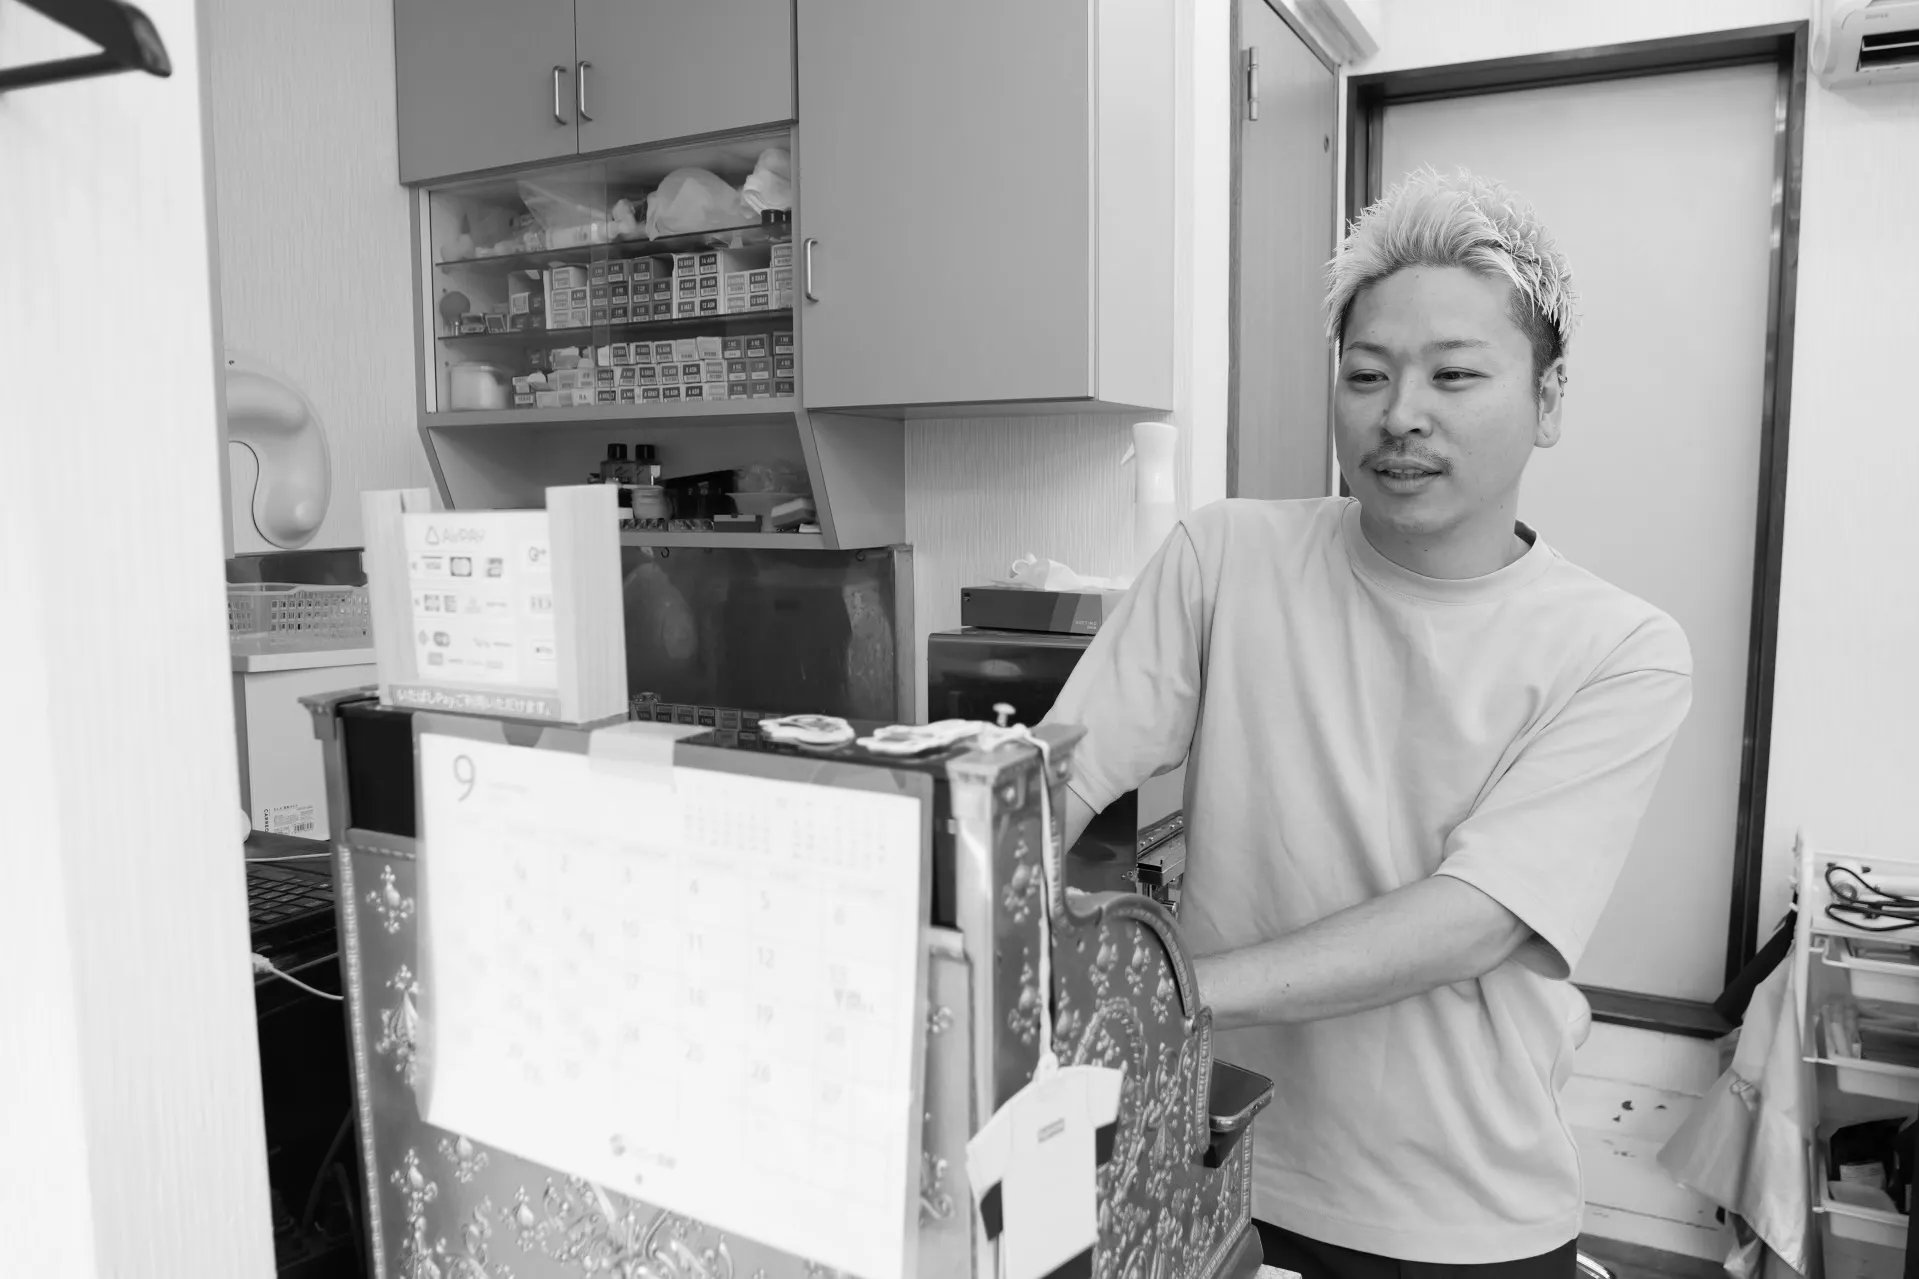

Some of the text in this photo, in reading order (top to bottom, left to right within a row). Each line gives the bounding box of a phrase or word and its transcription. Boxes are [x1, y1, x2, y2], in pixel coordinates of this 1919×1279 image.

[453, 753, 476, 803] 9
[689, 879, 700, 896] 4
[760, 890, 771, 911] 5
[688, 933, 704, 953] 11
[758, 945, 776, 971] 12
[688, 986, 708, 1009] 18
[756, 1003, 776, 1024] 19
[750, 1060, 772, 1085] 26
